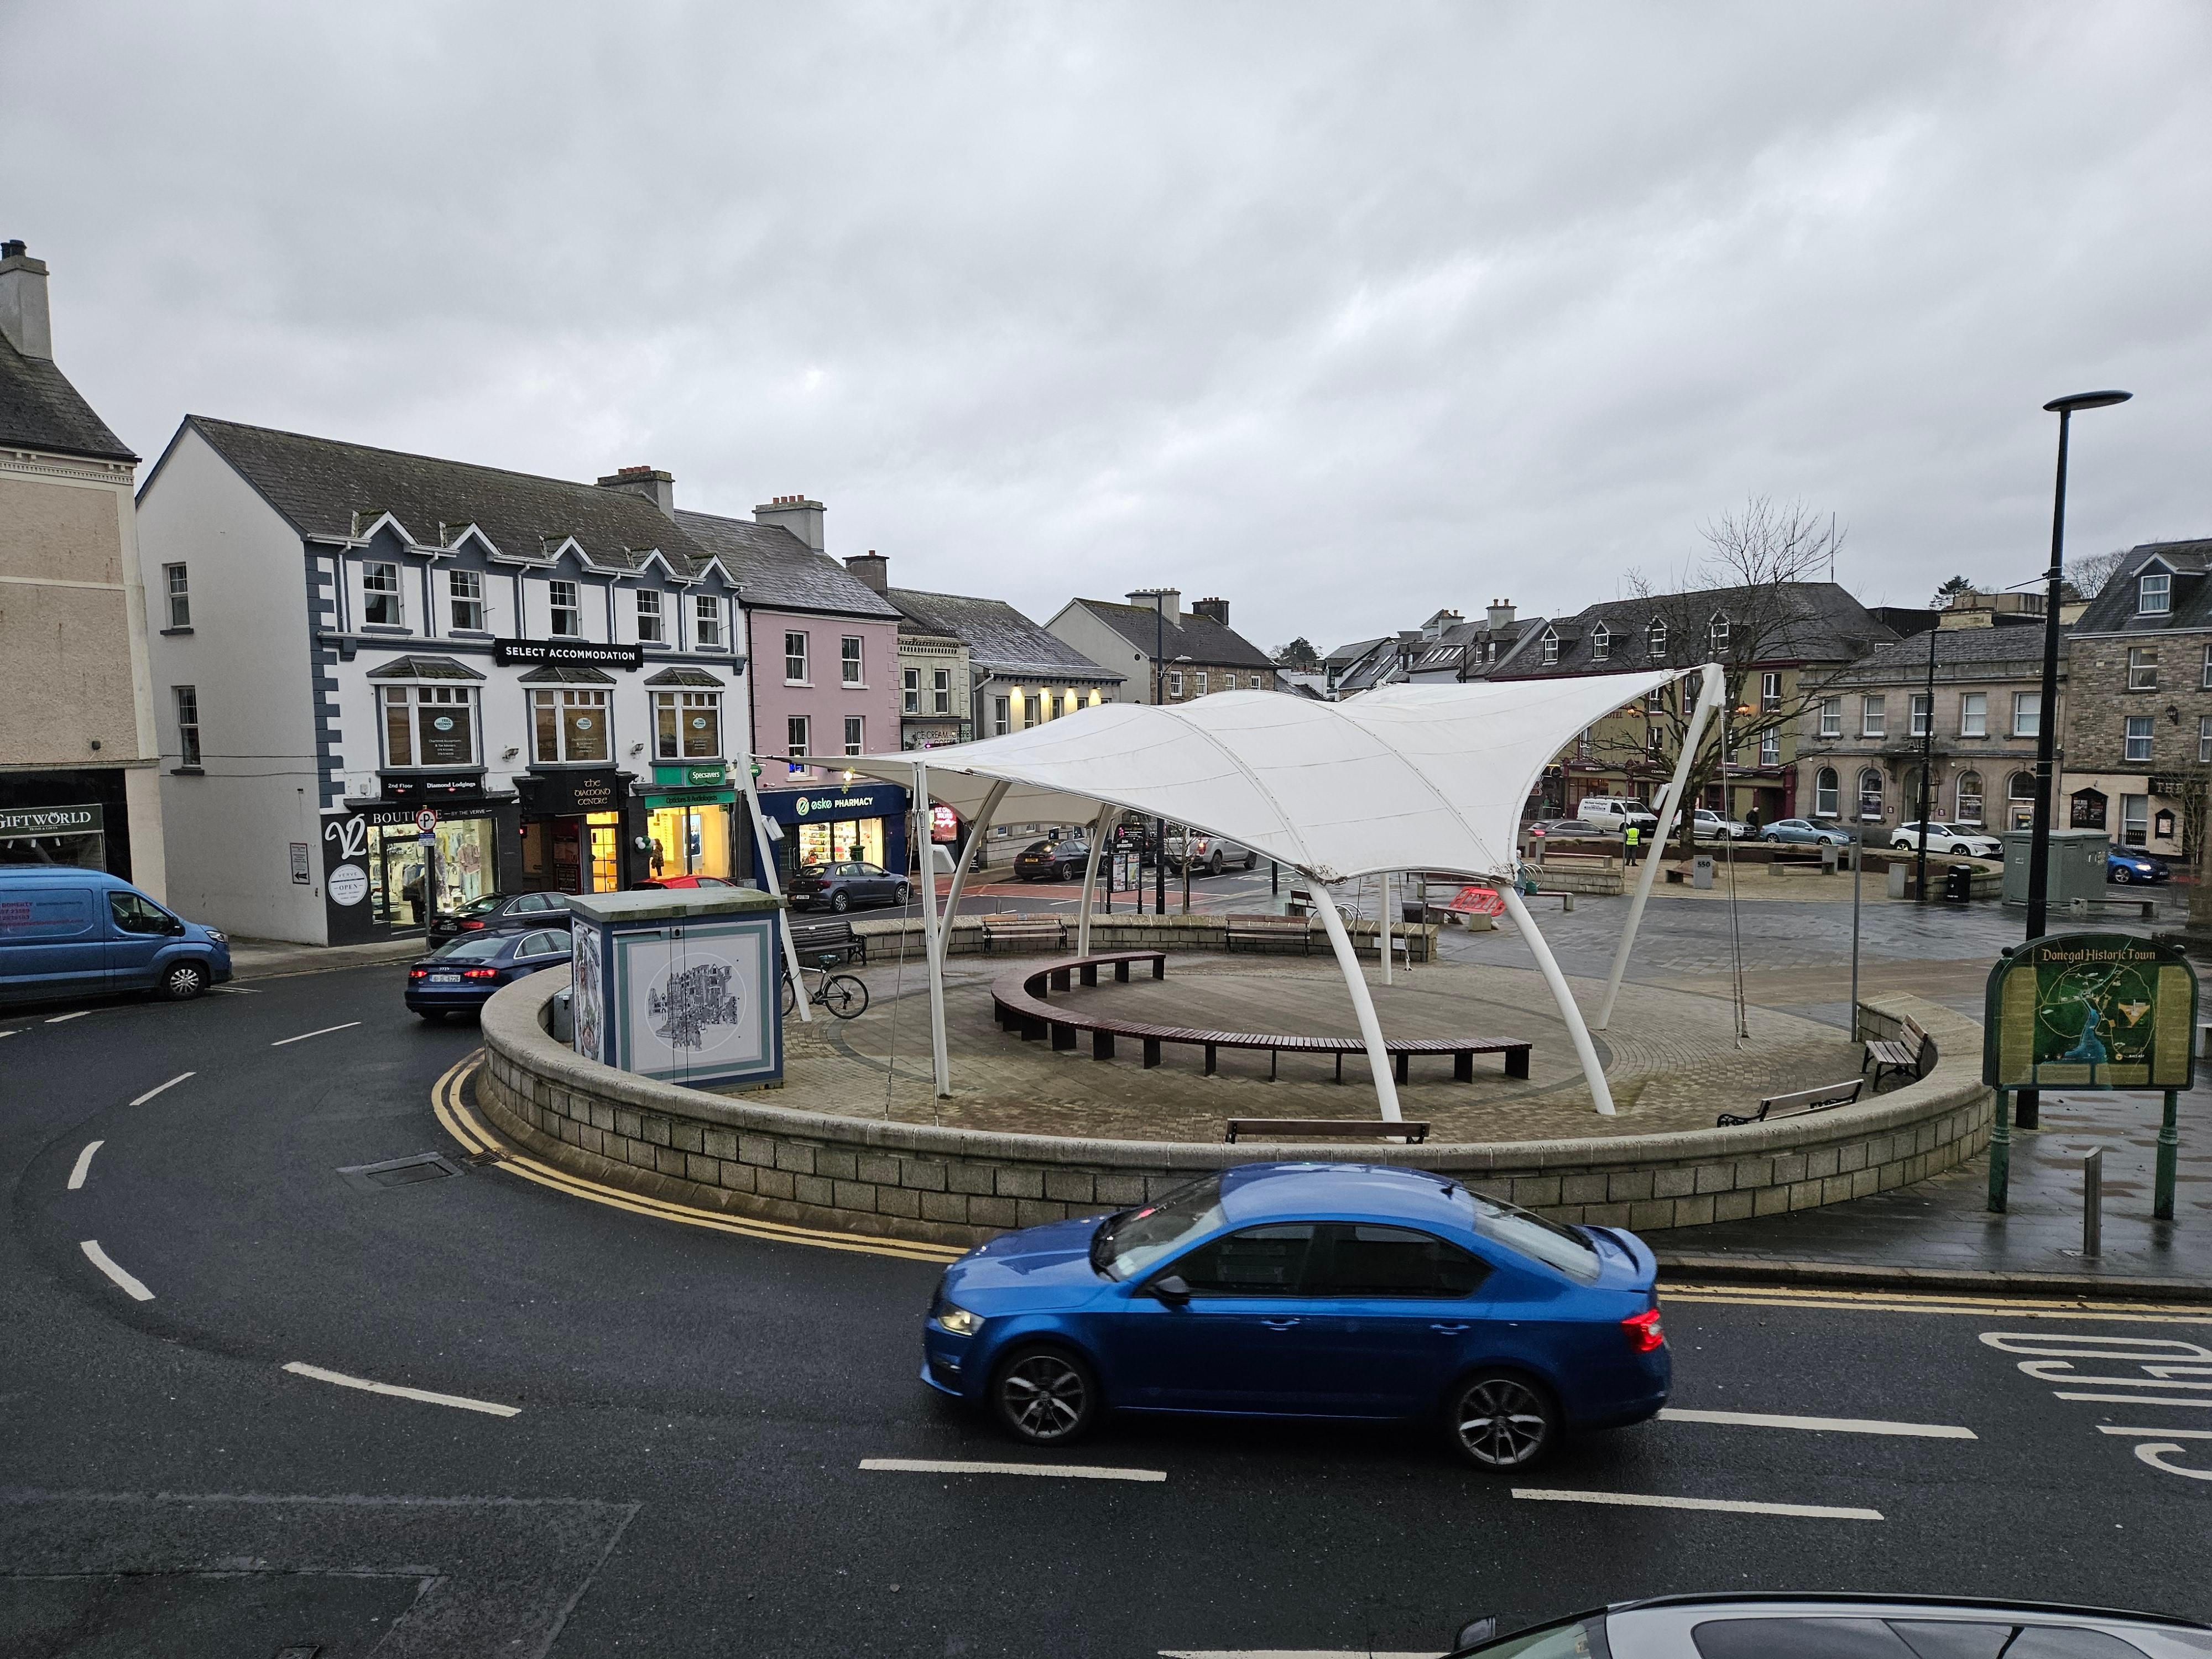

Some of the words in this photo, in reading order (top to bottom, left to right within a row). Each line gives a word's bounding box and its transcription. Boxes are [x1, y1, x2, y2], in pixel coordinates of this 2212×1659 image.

[506, 646, 545, 657] SELECT
[549, 649, 635, 660] ACCOMMODATION
[692, 771, 720, 780] Specsavers
[577, 797, 608, 806] CENTRE
[834, 797, 874, 808] PHARMACY
[0, 811, 91, 829] GIFTWORLD
[373, 810, 442, 824] BOUTIE
[423, 813, 430, 828] P
[2042, 948, 2084, 963] Donegal
[2085, 948, 2126, 961] Historic
[2127, 948, 2156, 960] Town
